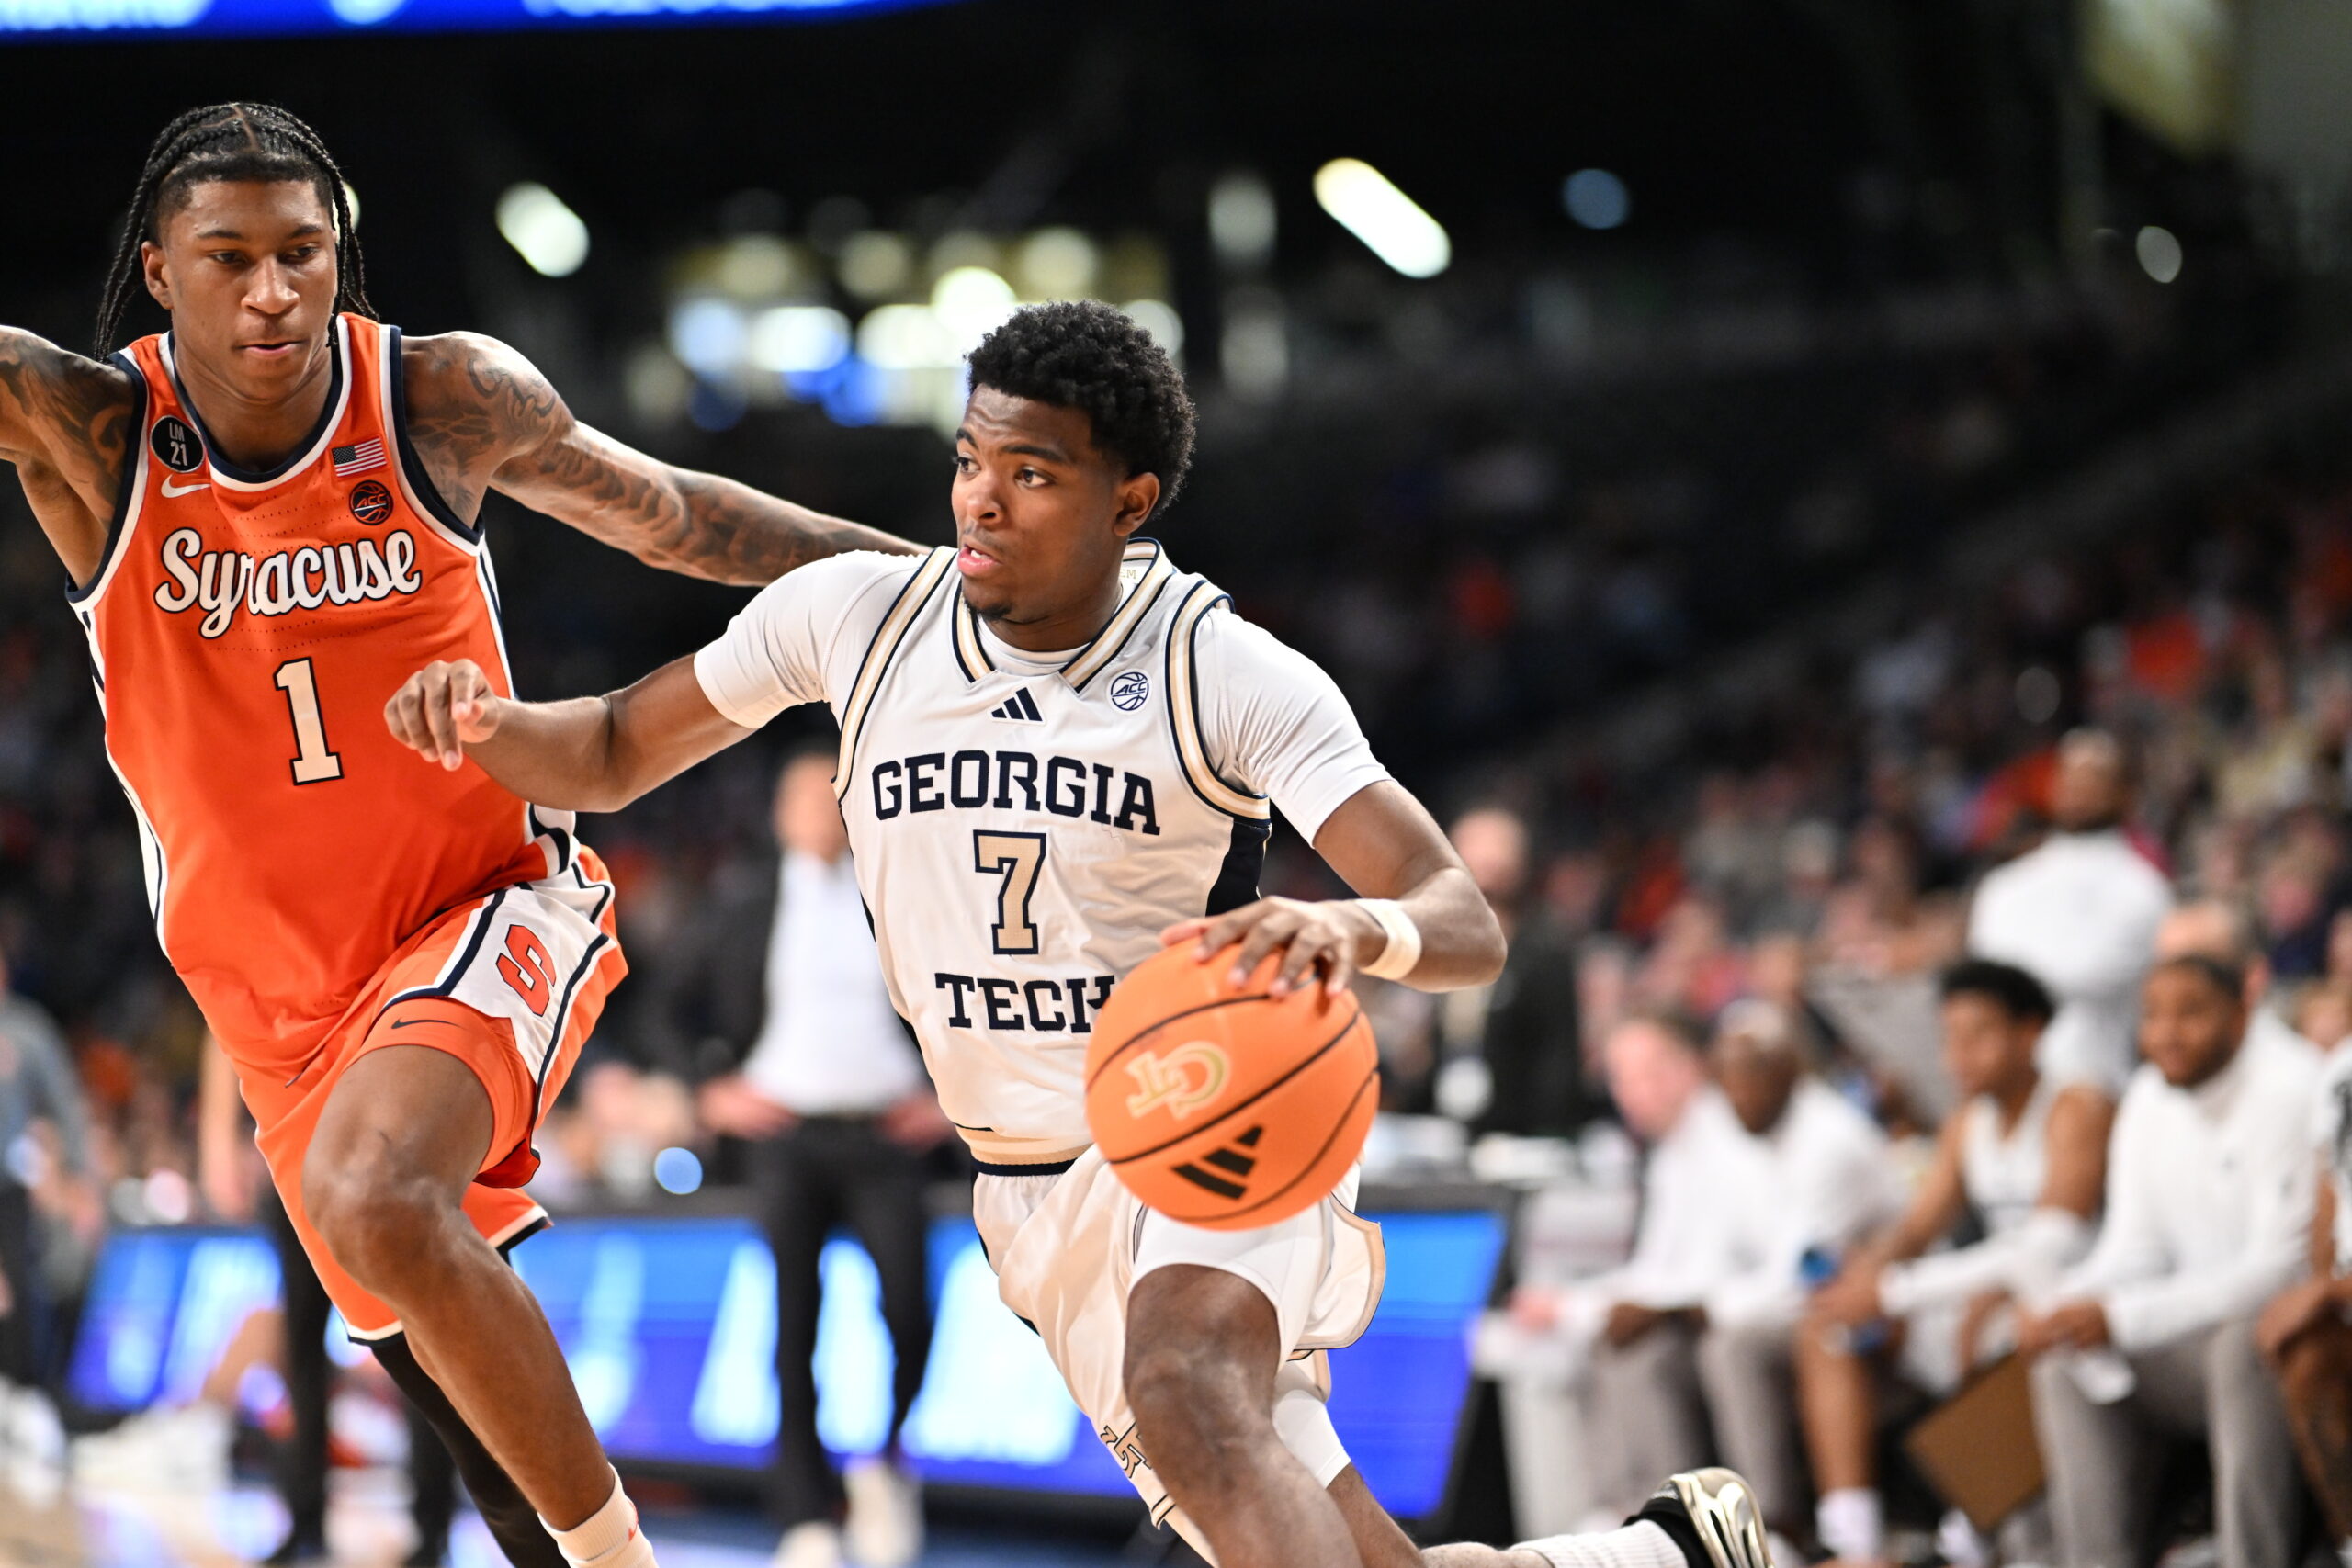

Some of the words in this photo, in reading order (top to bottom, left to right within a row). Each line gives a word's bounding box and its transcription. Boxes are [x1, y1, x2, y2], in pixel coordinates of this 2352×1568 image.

[169, 422, 186, 442] LM
[170, 441, 188, 466] 21
[356, 493, 387, 508] ACC
[154, 527, 422, 638] Syracuse
[273, 657, 344, 786] 1
[1114, 681, 1148, 695] ACC
[872, 750, 1160, 836] GEORGIA
[973, 829, 1046, 955] 7
[495, 924, 557, 1018] S
[934, 973, 1115, 1033] TECH
